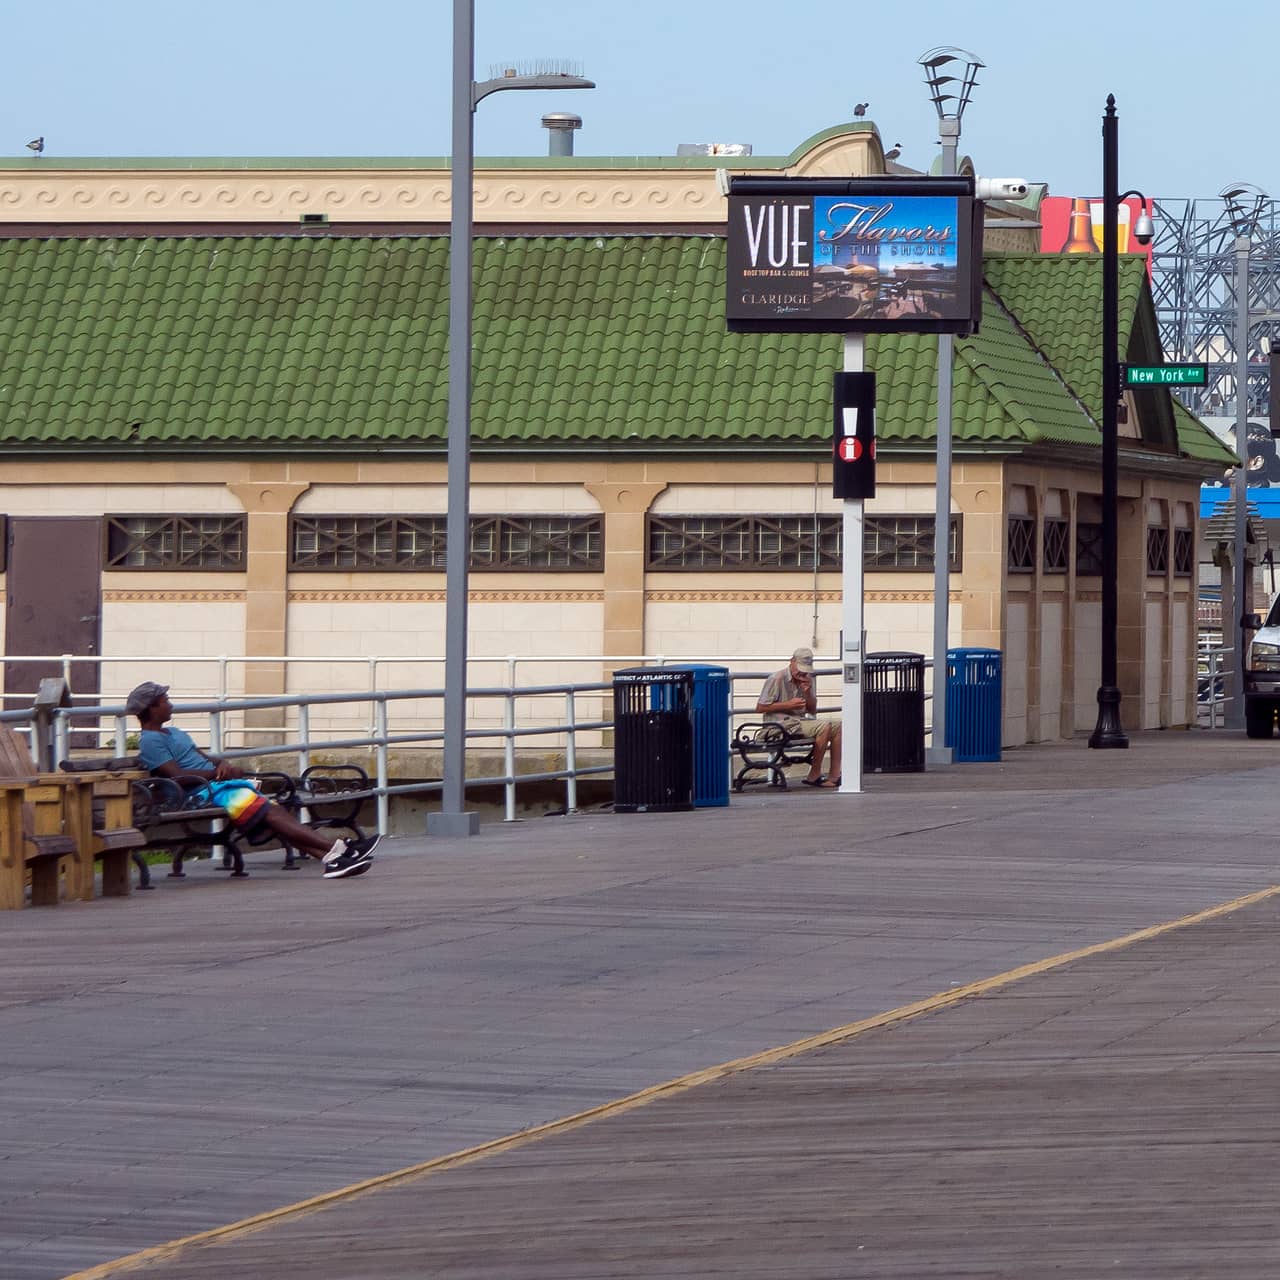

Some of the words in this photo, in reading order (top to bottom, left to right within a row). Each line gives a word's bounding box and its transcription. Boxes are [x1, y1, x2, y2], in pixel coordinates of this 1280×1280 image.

[818, 201, 952, 242] Flavors
[820, 244, 841, 256] OF
[850, 244, 880, 256] THE
[890, 244, 946, 256] SHORE
[742, 293, 811, 305] CLARIDGE
[1131, 369, 1153, 382] New
[1159, 369, 1185, 382] York
[1187, 368, 1200, 377] Ave
